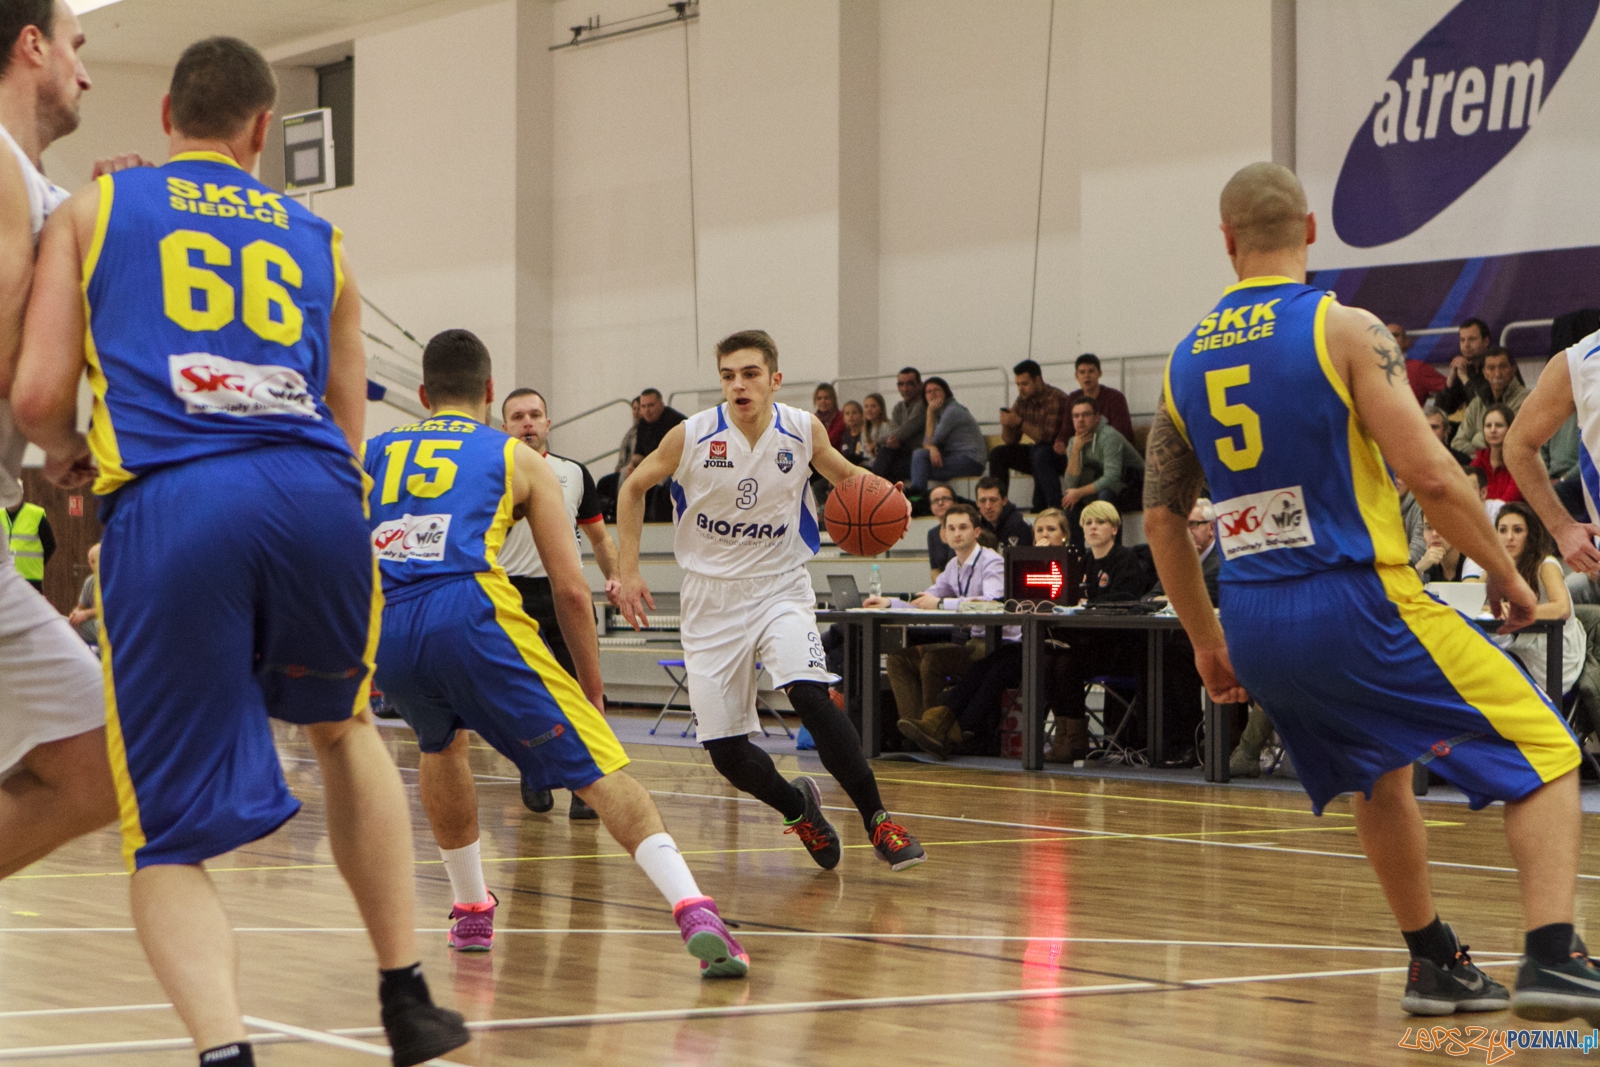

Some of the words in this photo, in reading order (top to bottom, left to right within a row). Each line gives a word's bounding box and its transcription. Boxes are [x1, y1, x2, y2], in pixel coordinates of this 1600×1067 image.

[1372, 57, 1545, 148] atrem
[167, 177, 288, 214] SKK
[169, 195, 290, 230] SIEDLCE
[159, 228, 304, 347] 66
[1196, 298, 1283, 337] SKK
[1191, 321, 1276, 355] SIEDLCE
[1204, 364, 1264, 472] 5
[381, 439, 464, 506] 15
[735, 477, 759, 511] 3
[696, 512, 790, 540] BIOFARM
